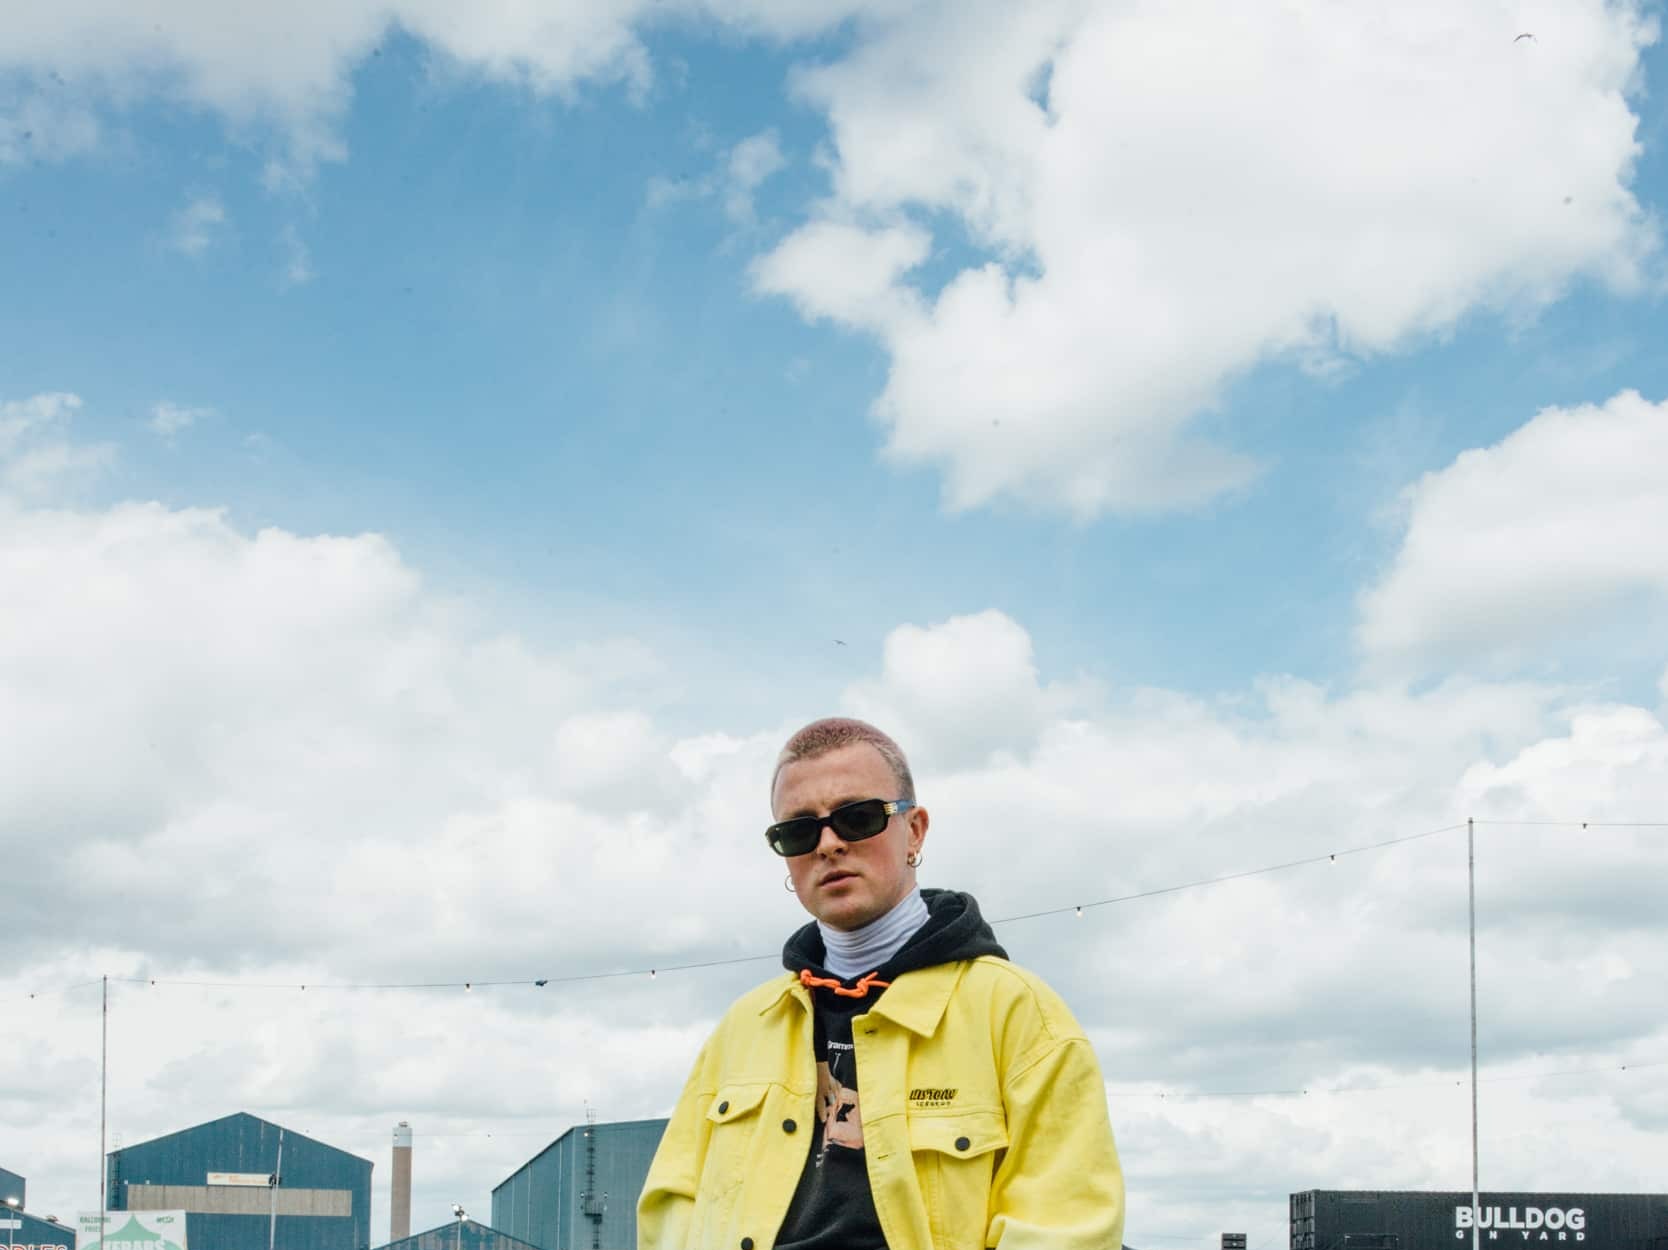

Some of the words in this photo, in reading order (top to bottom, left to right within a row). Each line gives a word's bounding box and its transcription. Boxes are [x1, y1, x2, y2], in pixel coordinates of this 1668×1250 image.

[1455, 1206, 1585, 1230] BULLDOG
[1455, 1230, 1498, 1240] GN
[1521, 1231, 1585, 1241] YARD
